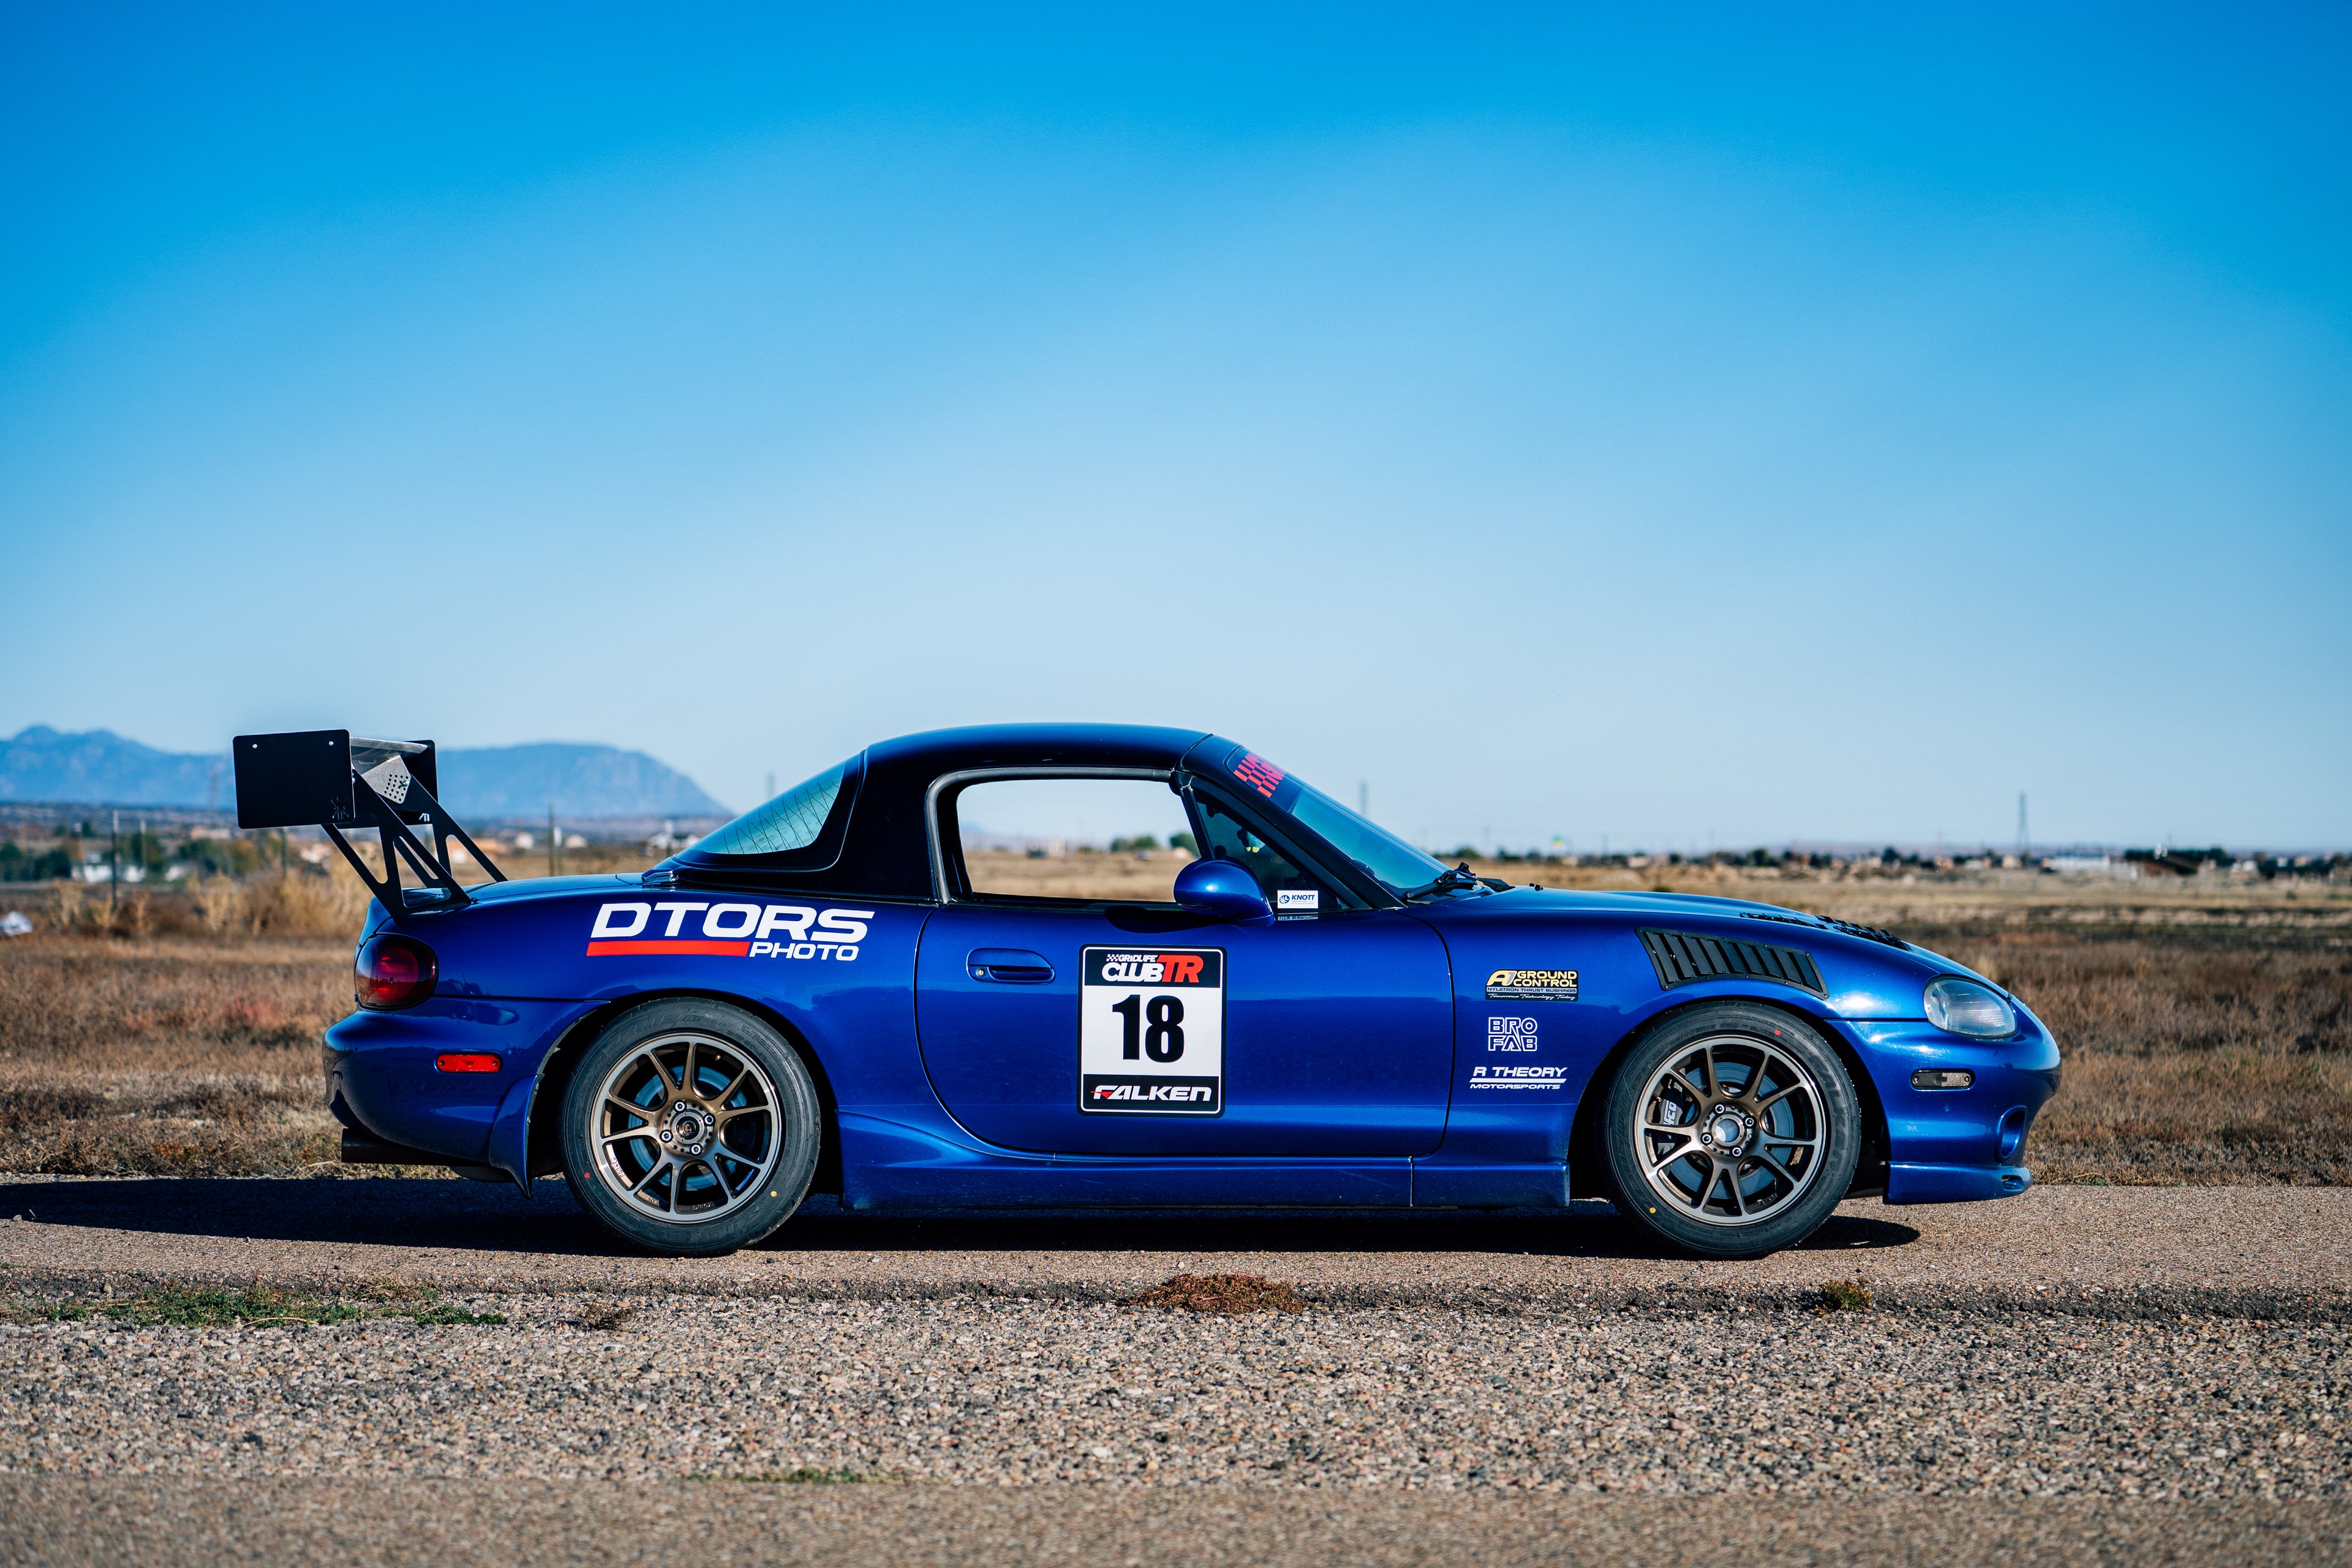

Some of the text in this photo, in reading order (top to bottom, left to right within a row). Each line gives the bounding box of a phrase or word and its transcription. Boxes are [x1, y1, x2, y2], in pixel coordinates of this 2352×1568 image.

[590, 902, 875, 943] DTORS
[749, 941, 859, 961] PHOTO
[1118, 954, 1158, 963] GRIDLIFE
[1513, 978, 1577, 987] CONTROL
[1517, 970, 1577, 979] GROUND
[1112, 994, 1185, 1063] 18
[1488, 1017, 1538, 1035] BRO
[1488, 1035, 1538, 1052] FAB
[1472, 1066, 1568, 1077] R THEORY
[1090, 1085, 1212, 1102] FALKEN
[1807, 1052, 1846, 1172] FALKEN
